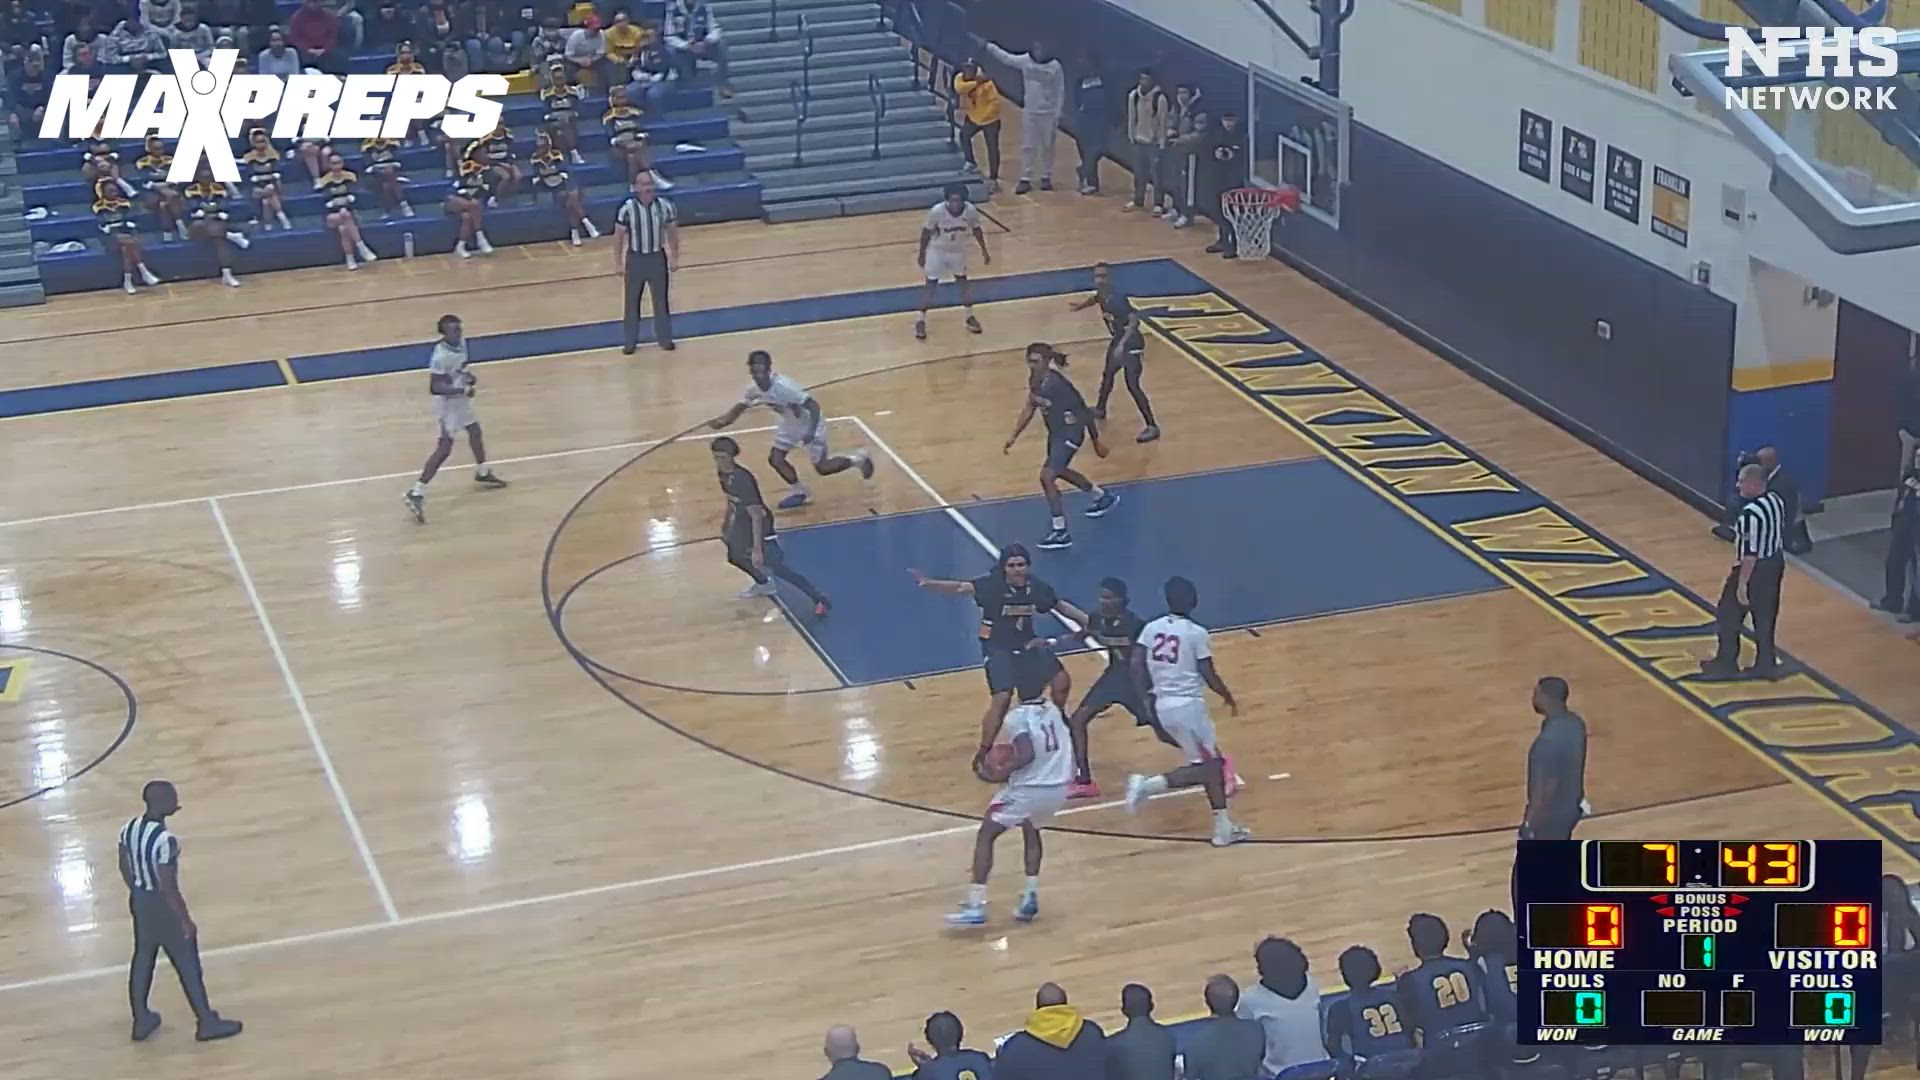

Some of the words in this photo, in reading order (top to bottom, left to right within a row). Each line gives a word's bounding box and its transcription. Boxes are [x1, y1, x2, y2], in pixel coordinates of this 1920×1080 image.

[1127, 292, 1520, 495] FRANKLIN
[1152, 632, 1181, 665] 23
[1040, 720, 1060, 752] 11
[1433, 971, 1471, 1008] 20
[1363, 1003, 1403, 1037] 32
